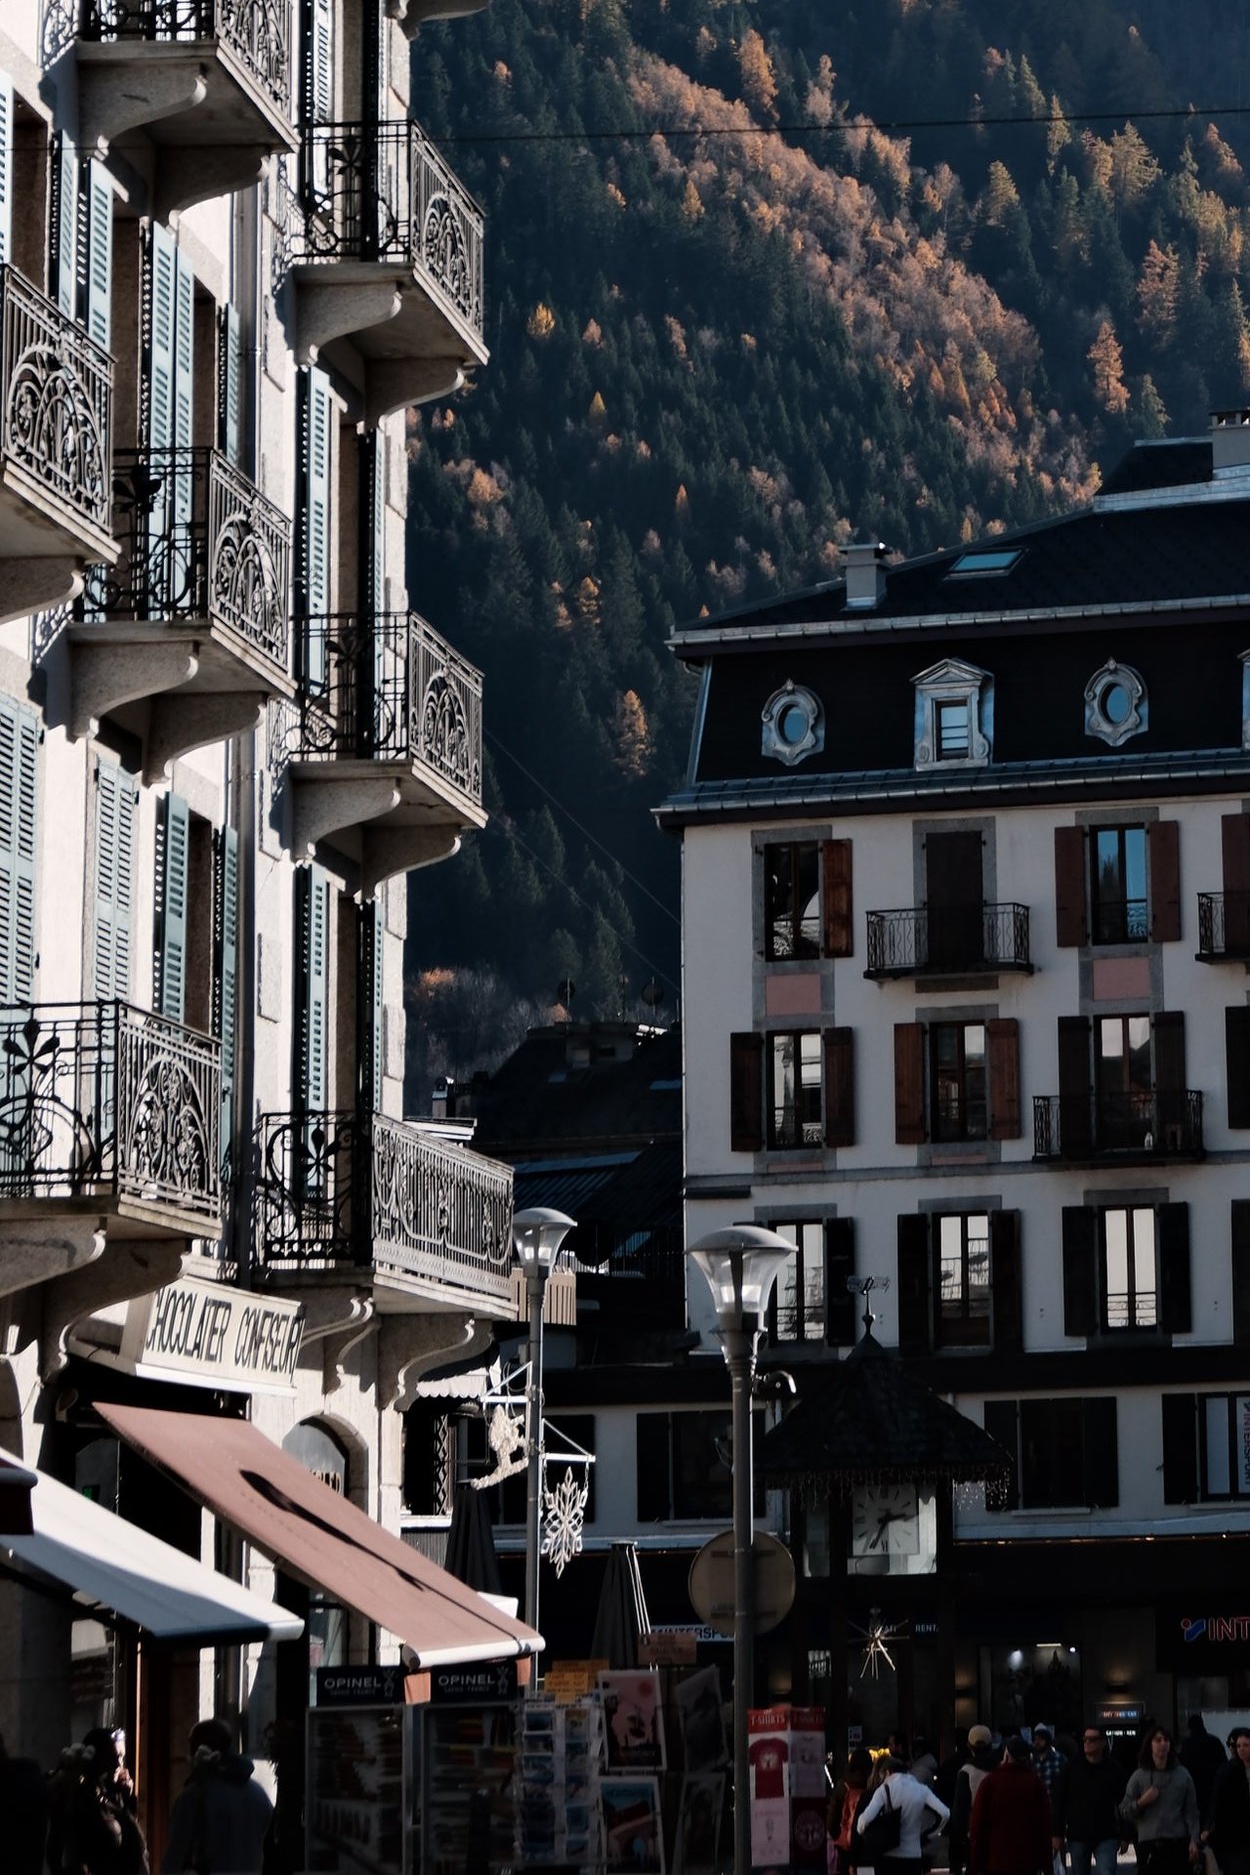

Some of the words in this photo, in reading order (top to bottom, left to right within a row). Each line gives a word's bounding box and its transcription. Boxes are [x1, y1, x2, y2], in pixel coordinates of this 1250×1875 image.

[145, 1286, 232, 1363] CHOCOLATIER
[324, 1676, 382, 1690] OPINEL
[438, 1673, 496, 1687] OPINEL
